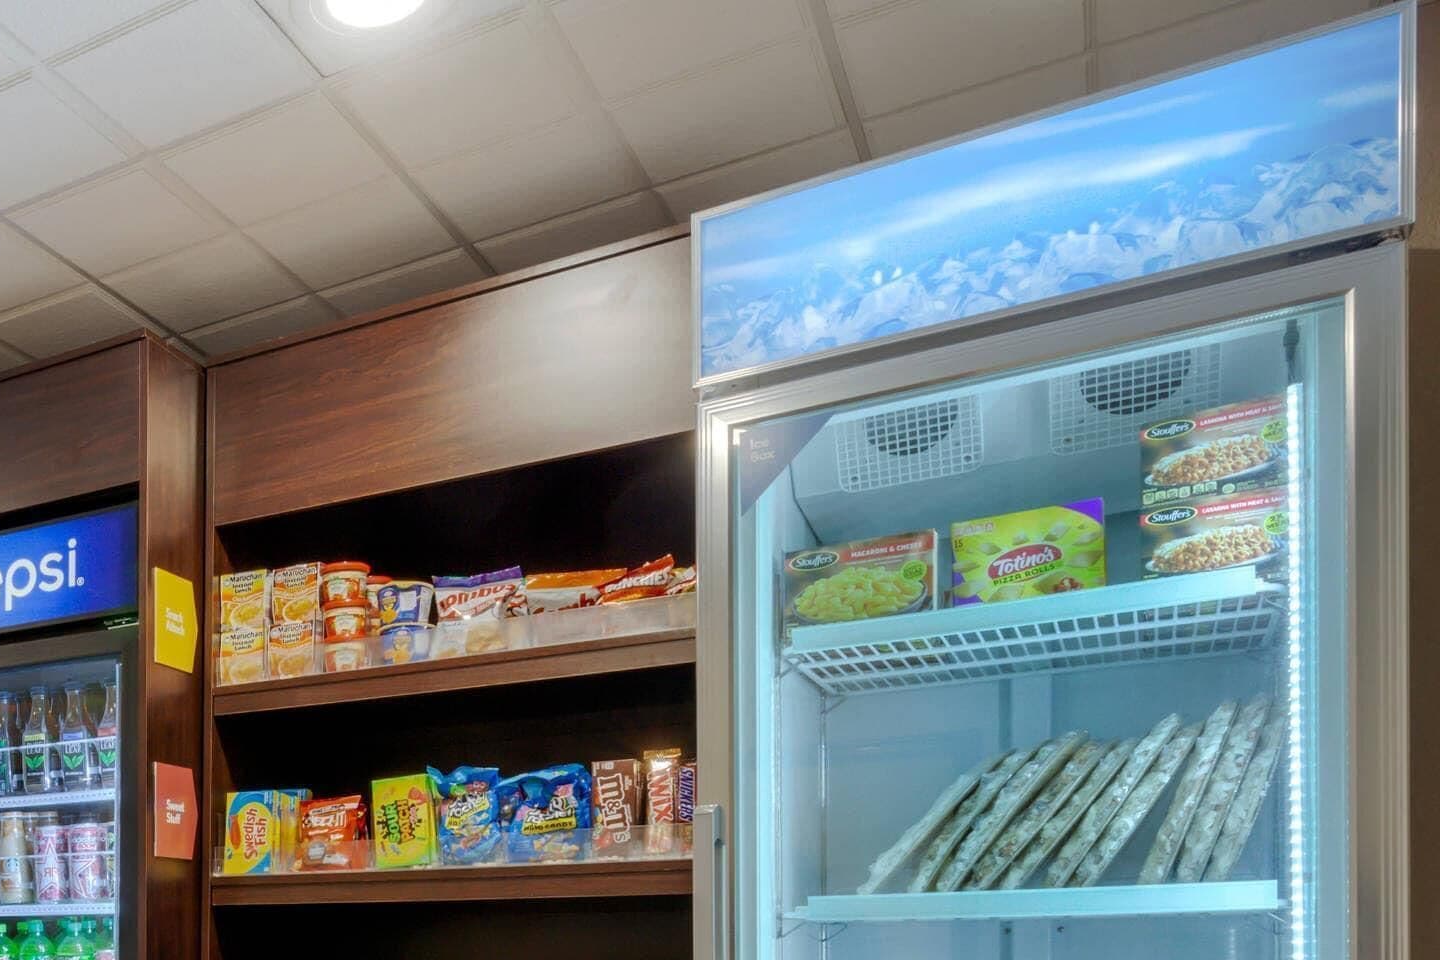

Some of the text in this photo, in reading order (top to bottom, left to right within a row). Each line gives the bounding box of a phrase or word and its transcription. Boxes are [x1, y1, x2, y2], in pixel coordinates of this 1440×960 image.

[1247, 499, 1264, 507] MEAT
[1151, 509, 1191, 523] Stouffer's
[851, 547, 888, 558] MACARONI
[993, 546, 1055, 577] Totino's
[229, 573, 263, 584] Maruchan
[282, 567, 317, 578] Maruchan
[992, 563, 1056, 587] PIZZA ROLLS
[230, 630, 263, 641] Maruchan
[278, 622, 313, 633] Maruchan
[678, 767, 694, 823] SNICKERS
[386, 800, 399, 845] SOUR
[397, 798, 414, 844] PATCH
[244, 806, 258, 860] Swedish
[255, 817, 268, 846] Fish
